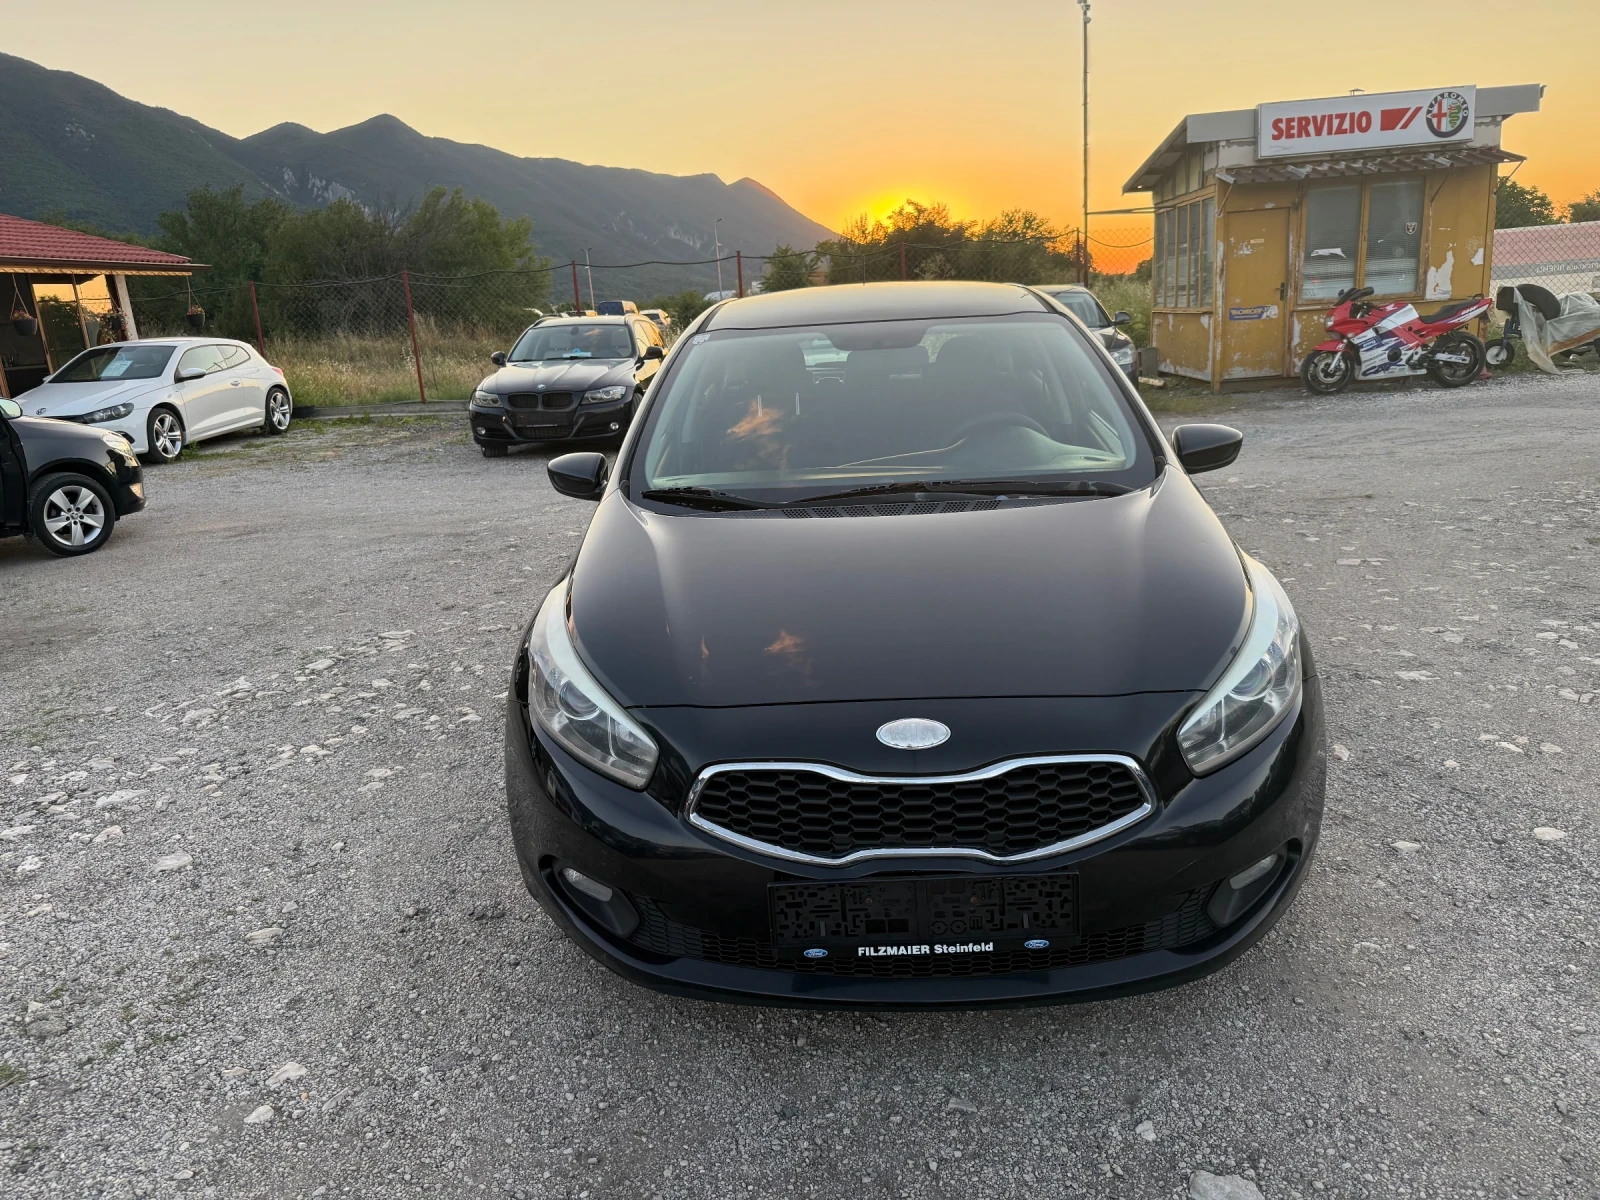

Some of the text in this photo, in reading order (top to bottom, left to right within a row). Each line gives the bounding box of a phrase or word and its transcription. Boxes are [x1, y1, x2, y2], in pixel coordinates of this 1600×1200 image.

[1271, 110, 1373, 141] SERVIZIO
[857, 942, 994, 957] FILZMAIER Steinfeld
